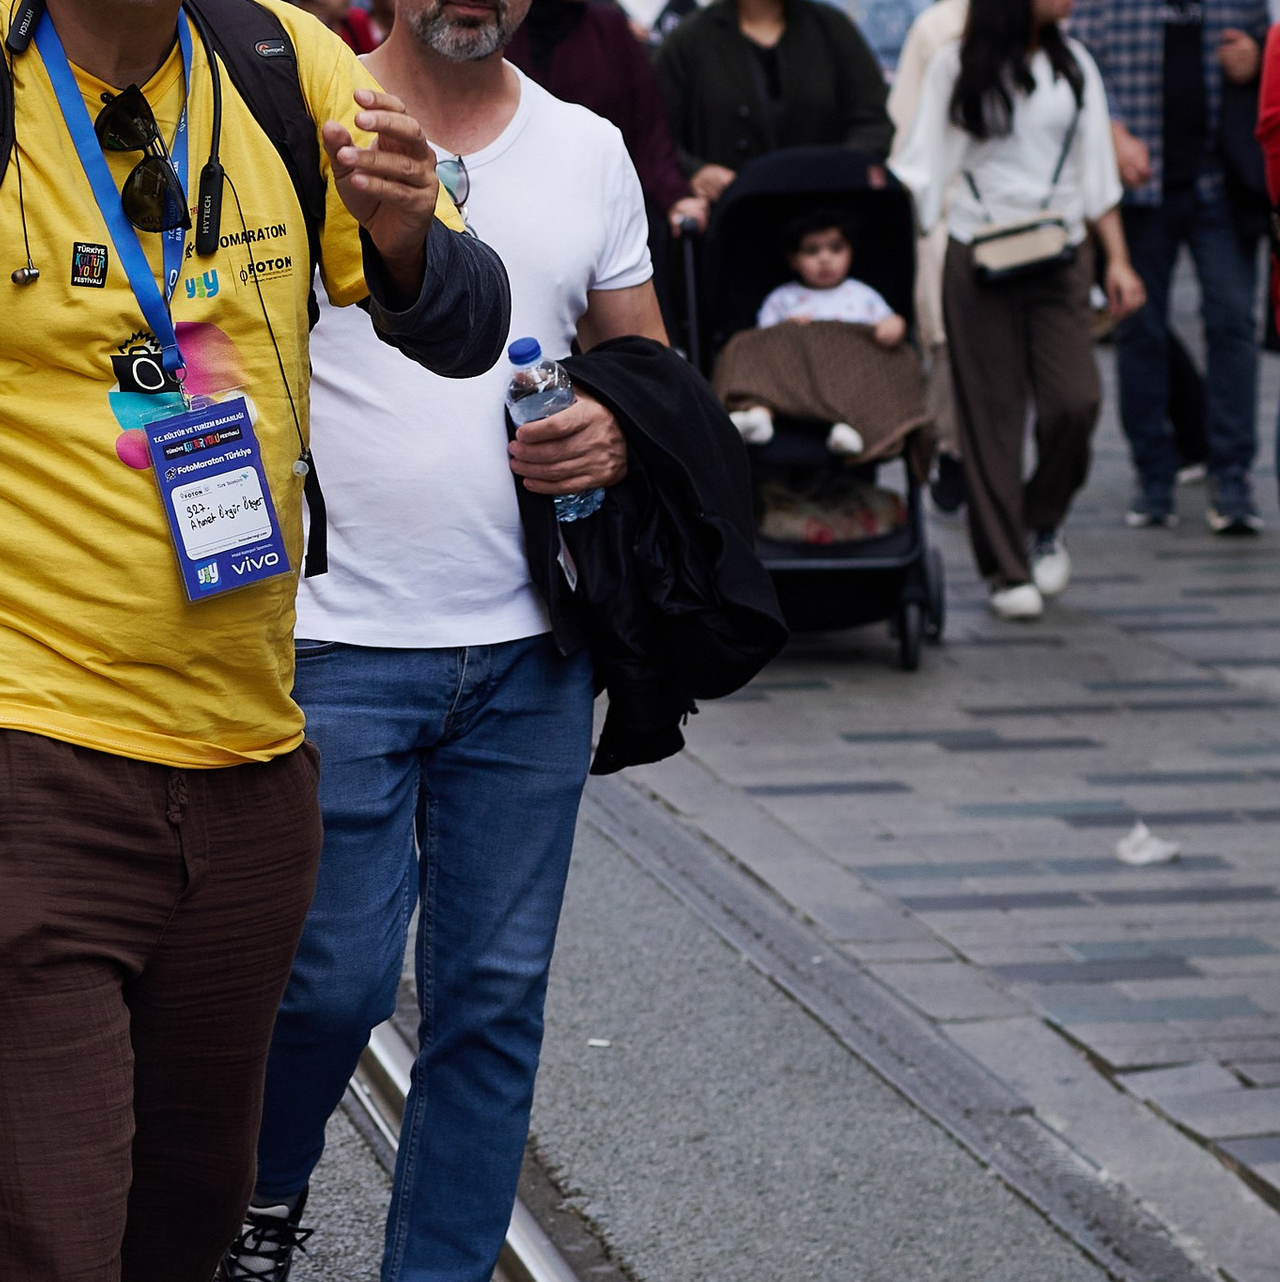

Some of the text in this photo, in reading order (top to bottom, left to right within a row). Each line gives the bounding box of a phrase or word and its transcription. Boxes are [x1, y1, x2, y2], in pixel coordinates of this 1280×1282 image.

[18, 8, 34, 36] HYTECH
[202, 195, 212, 234] HYTECH
[220, 223, 287, 248] OMARATON
[77, 245, 106, 255] TÜRKİYE
[177, 448, 252, 475] FotoMaraton Türkiye
[231, 552, 279, 575] vivo
